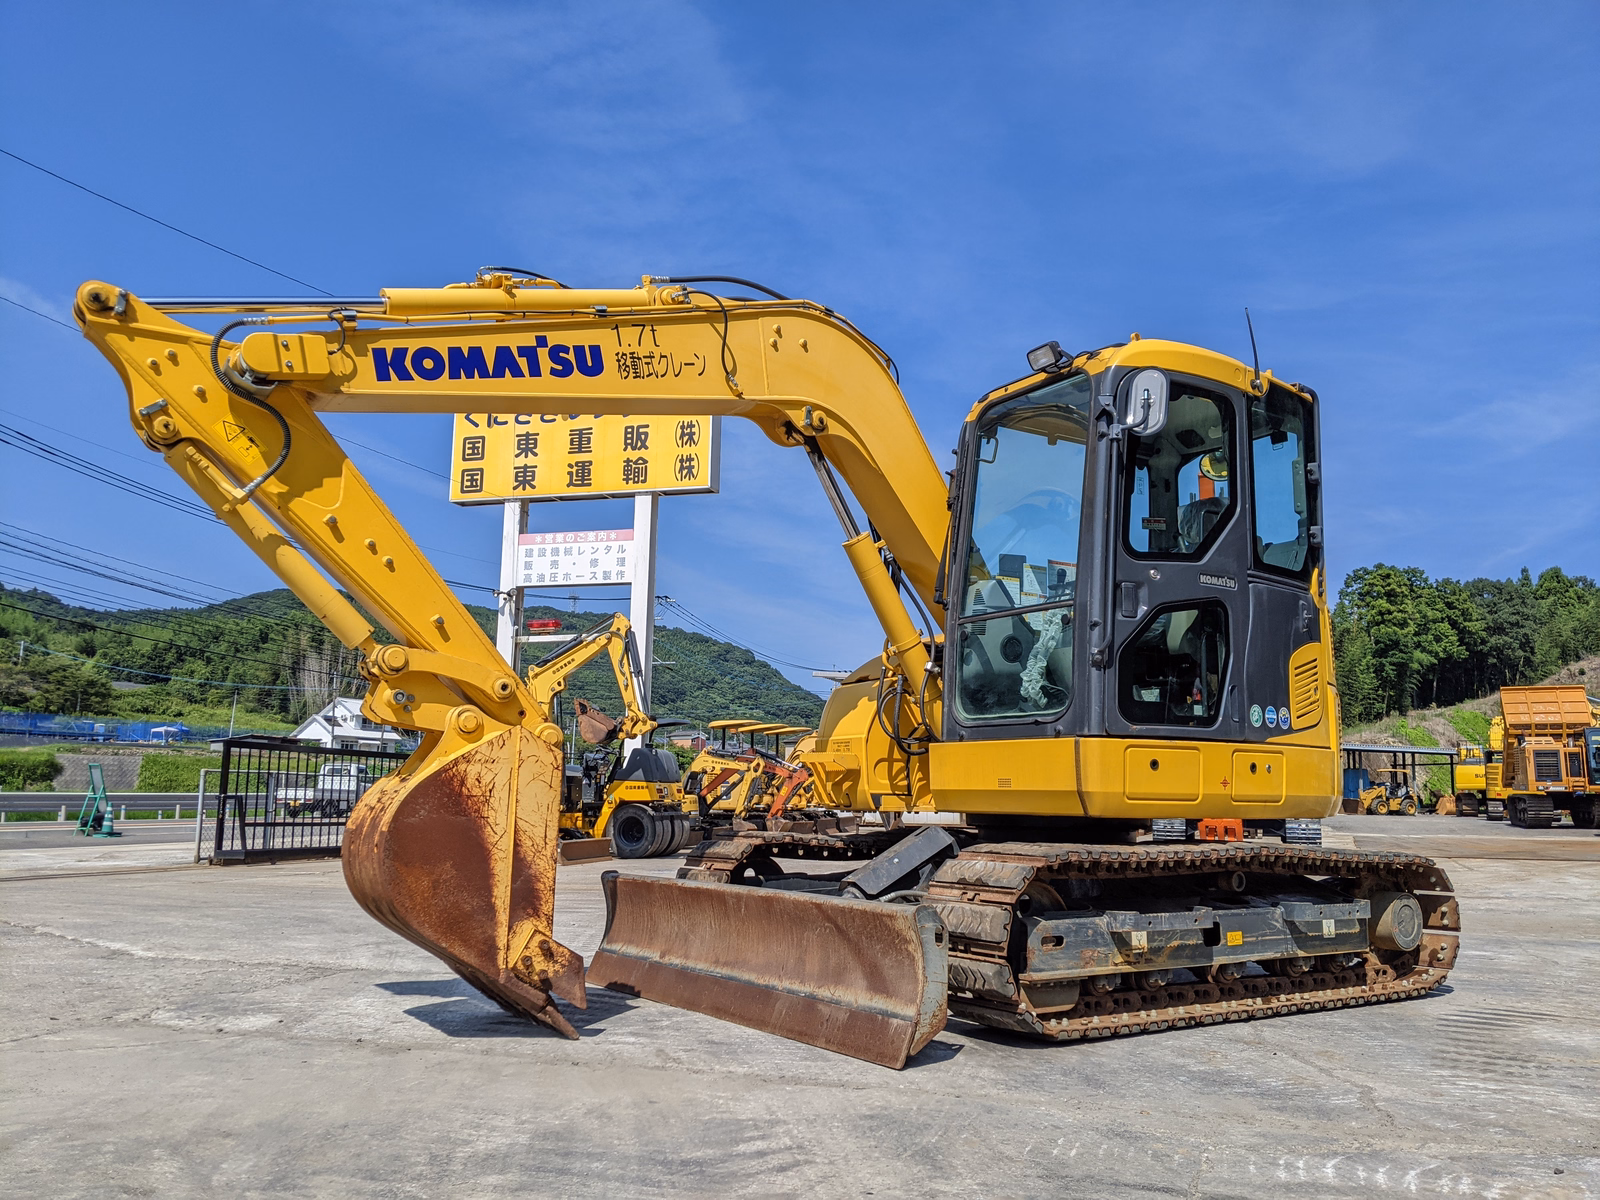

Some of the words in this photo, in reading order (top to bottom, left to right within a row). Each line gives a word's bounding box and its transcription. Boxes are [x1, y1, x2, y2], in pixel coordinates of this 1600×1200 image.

[611, 323, 660, 348] 1.7t
[371, 335, 604, 382] KOMATSU
[616, 351, 706, 380] 移動式クレーン
[524, 544, 627, 558] 建設機械レンタル
[522, 569, 626, 583] 高油圧ホース製作
[1200, 574, 1235, 588] KOMATSU
